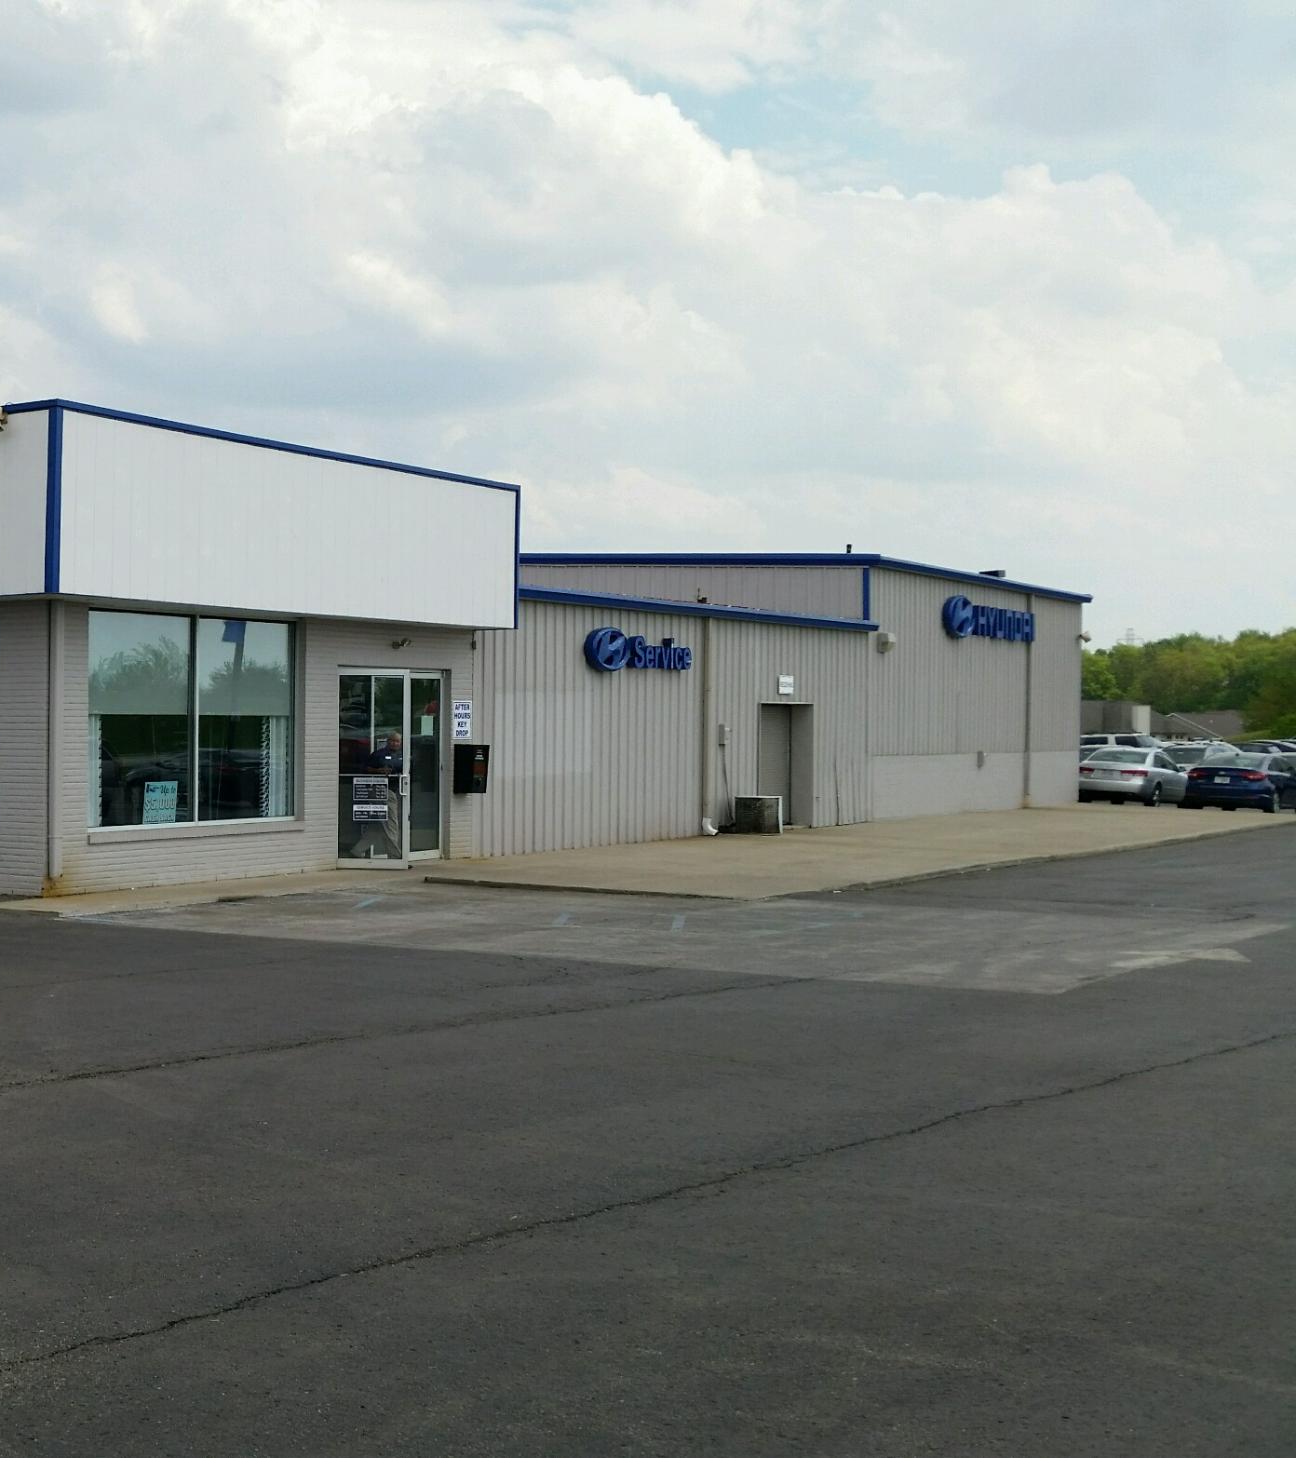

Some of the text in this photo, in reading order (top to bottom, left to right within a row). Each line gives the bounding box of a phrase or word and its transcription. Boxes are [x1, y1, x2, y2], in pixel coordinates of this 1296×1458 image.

[627, 635, 692, 670] Service
[454, 703, 470, 711] AFTER
[453, 712, 471, 720] HOURS
